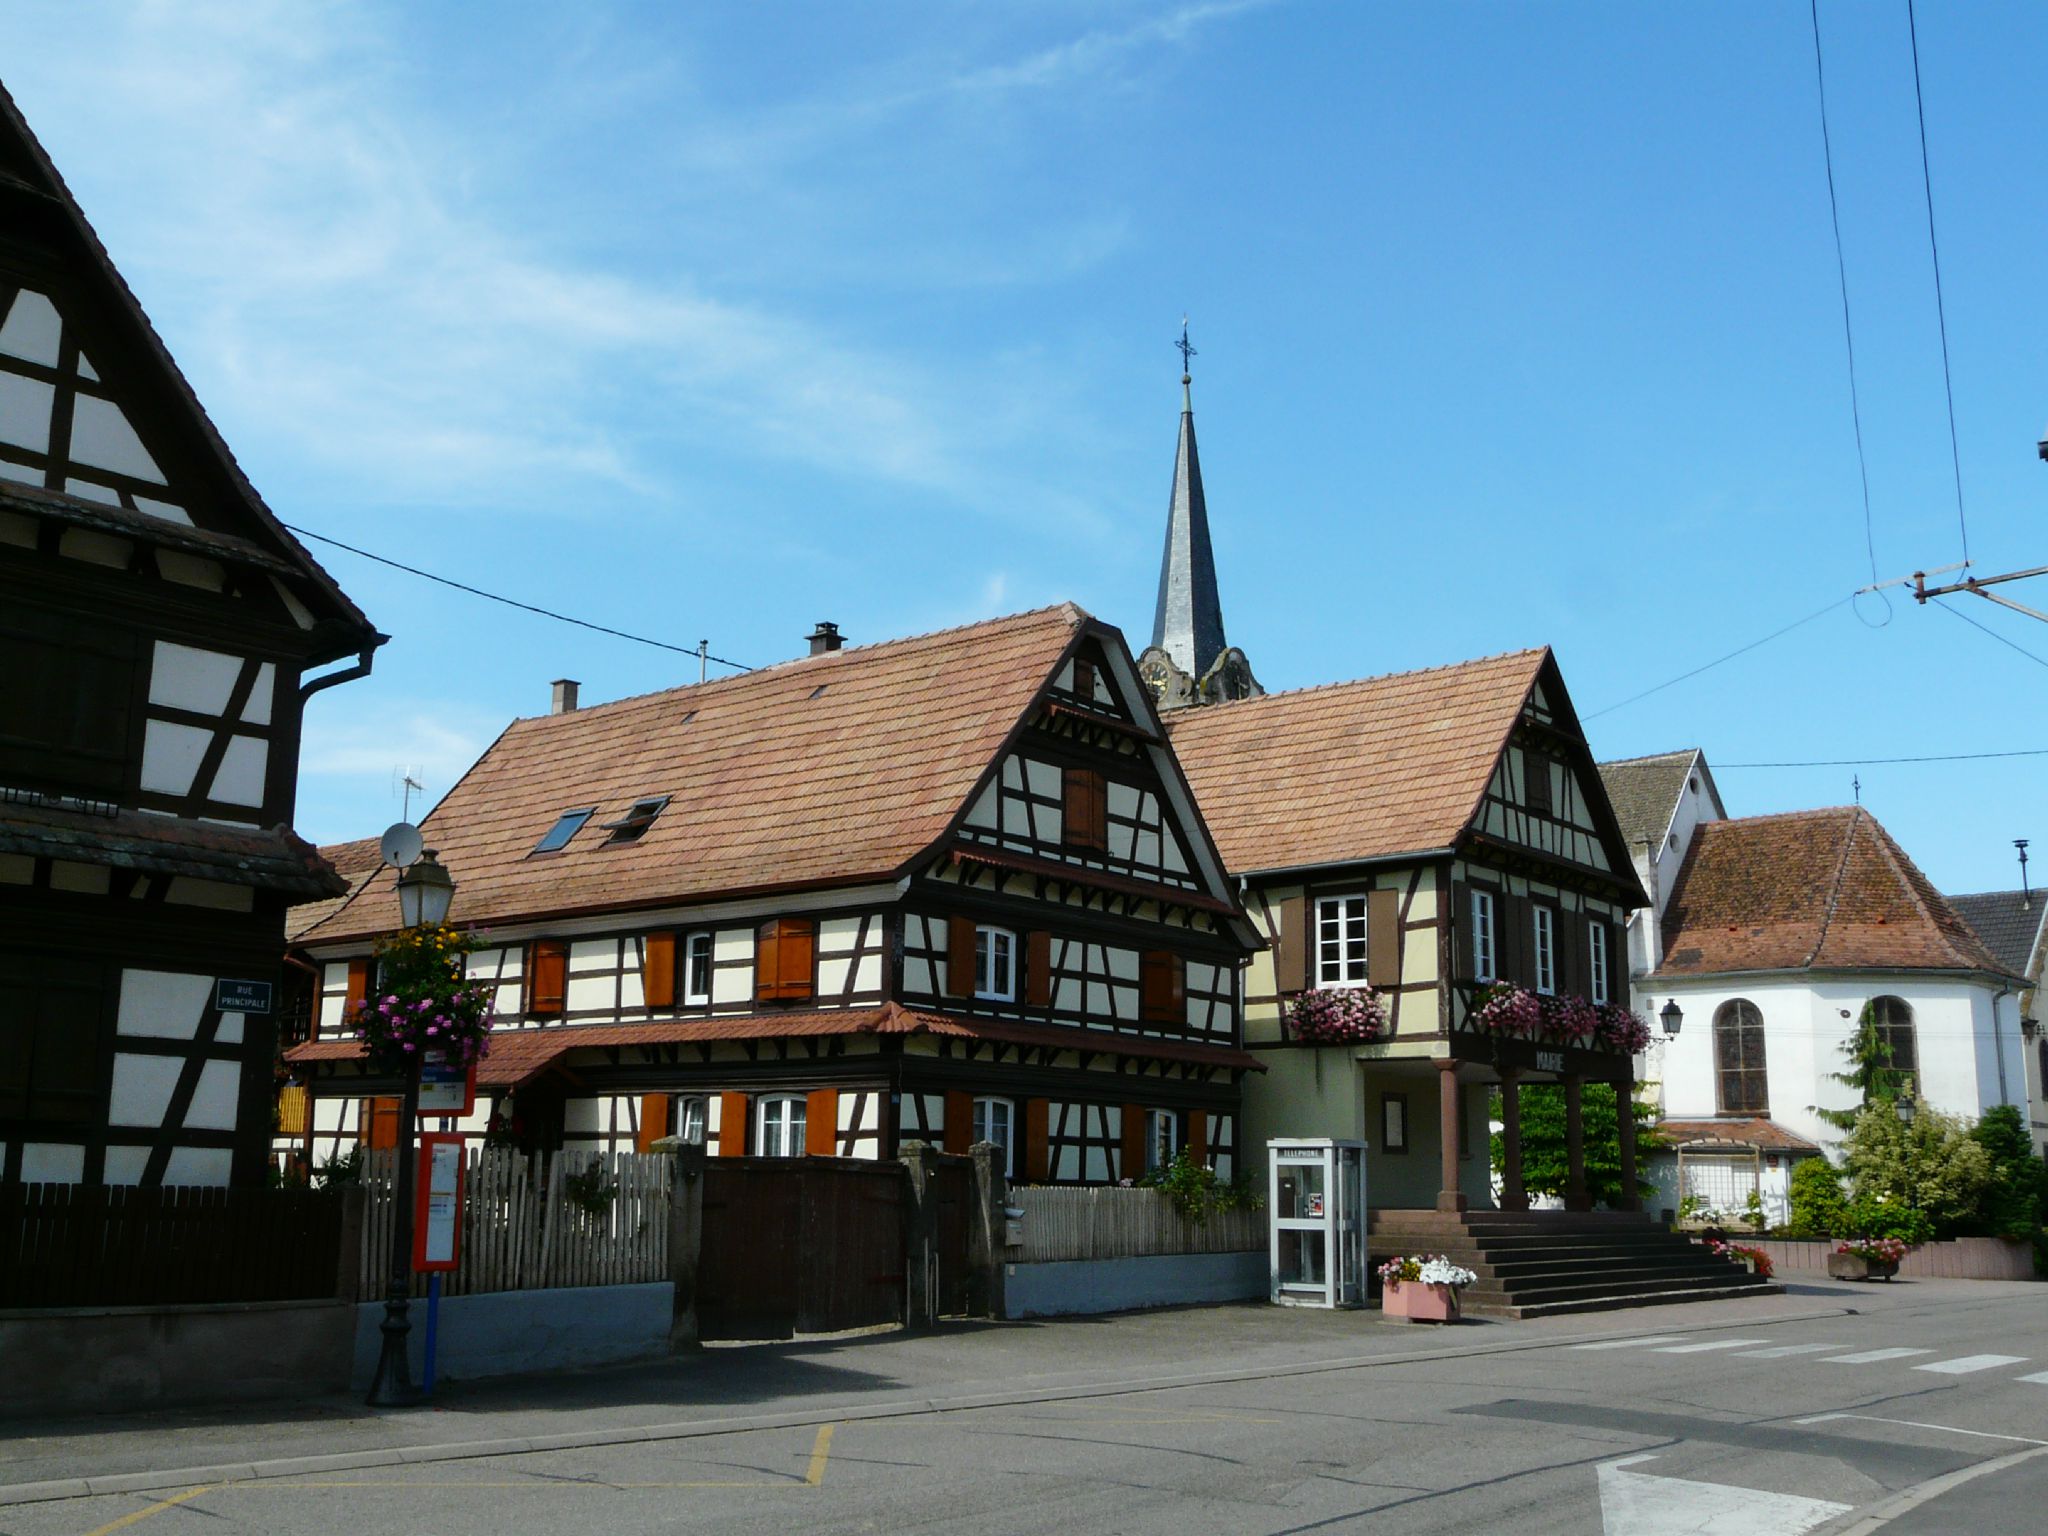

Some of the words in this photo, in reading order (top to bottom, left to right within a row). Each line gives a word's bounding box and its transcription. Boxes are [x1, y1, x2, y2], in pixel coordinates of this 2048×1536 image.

[237, 985, 253, 995] RUE
[221, 996, 265, 1008] PRINCIPALE
[1536, 1050, 1565, 1072] MAIRIE
